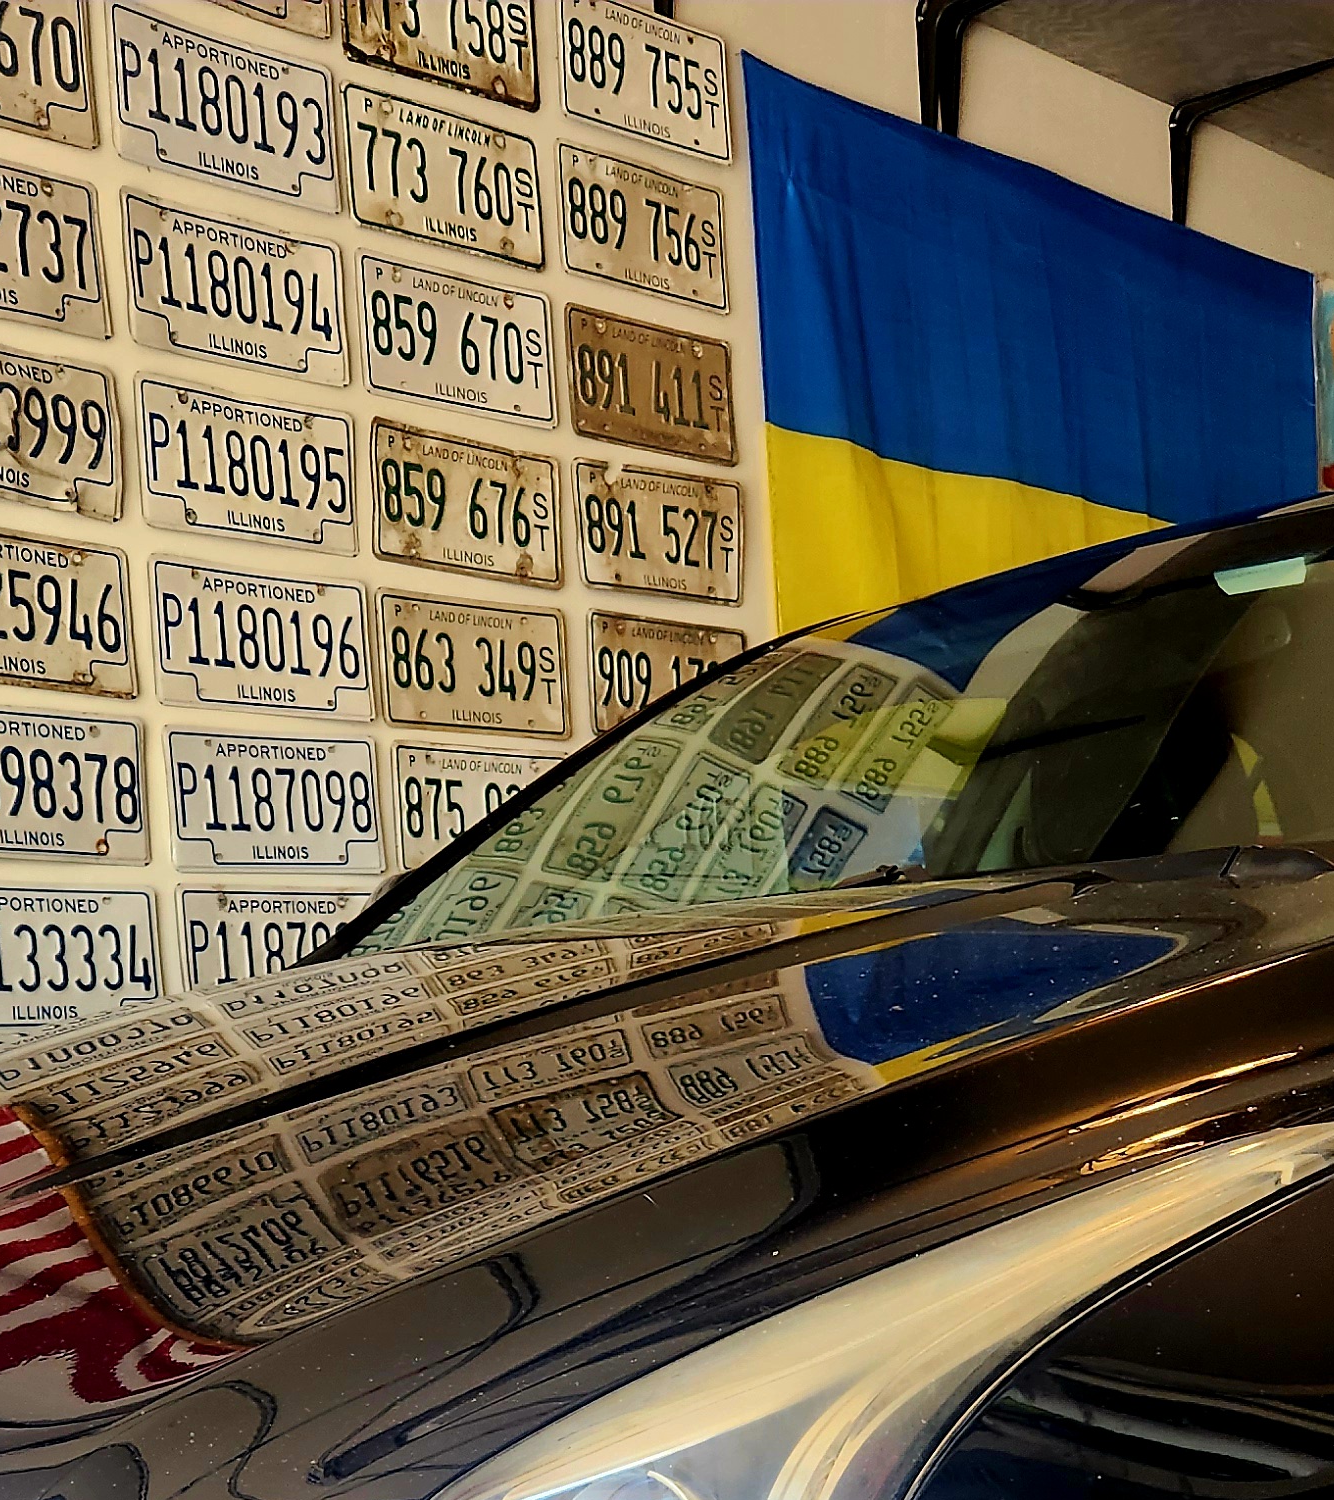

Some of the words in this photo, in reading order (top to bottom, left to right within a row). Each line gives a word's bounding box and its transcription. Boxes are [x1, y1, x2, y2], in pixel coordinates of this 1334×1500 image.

[605, 8, 629, 26] LAND
[631, 17, 643, 29] OF
[645, 25, 680, 44] LINCOLN
[162, 32, 279, 80] APPORTIONED
[418, 51, 470, 79] ILLINOIS
[568, 18, 625, 95] 889
[645, 44, 701, 120] 755
[120, 38, 326, 165] P1180193
[365, 98, 373, 112] P
[399, 109, 429, 128] LAND
[432, 118, 445, 133] OF
[448, 123, 491, 147] LINCOLN
[624, 114, 670, 138] ILLINOIS
[199, 151, 259, 180] ILLINOIS
[357, 121, 428, 203] 773
[449, 147, 514, 226] 760
[173, 219, 287, 258] APPORTIONED
[425, 216, 477, 242] ILLINOIS
[568, 177, 626, 250] 889
[645, 198, 700, 272] 756
[134, 228, 332, 341] P1180194
[413, 277, 440, 293] LAND
[442, 284, 455, 296] OF
[458, 287, 499, 307] LINCOLN
[625, 268, 670, 290] ILLINOIS
[209, 333, 267, 359] ILLINOIS
[371, 290, 437, 366] 859
[461, 312, 524, 384] 670
[435, 382, 488, 403] ILLINOIS
[577, 343, 635, 416] 891
[653, 360, 709, 430] 411
[191, 399, 302, 432] APPORTIONED
[149, 412, 346, 513] P1180195
[423, 444, 449, 460] LAND
[452, 451, 465, 463] OF
[467, 453, 509, 472] LINCOLN
[382, 458, 445, 531] 859
[469, 478, 531, 547] 676
[228, 510, 285, 532] ILLINOIS
[585, 494, 646, 560] 891
[663, 504, 717, 569] 527
[443, 548, 494, 567] ILLINOIS
[203, 577, 314, 603] APPORTIONED
[644, 575, 687, 590] ILLINOIS
[430, 610, 455, 623] LAND
[458, 613, 470, 625] OF
[473, 615, 512, 630] LINCOLN
[163, 593, 359, 679] P1180196
[392, 626, 456, 694] 863
[476, 637, 536, 701] 349
[238, 684, 296, 701] ILLINOIS
[598, 646, 651, 711] 909
[452, 709, 502, 724] ILLINOIS
[216, 743, 326, 761] APPORTIONED
[442, 759, 467, 771] LAND
[470, 761, 481, 771] OF
[484, 761, 522, 774] LINCOLN
[177, 762, 372, 833] P1187098
[405, 776, 465, 840] 875
[0, 829, 65, 846] ILLINOIS
[253, 846, 309, 860] ILLINOIS
[228, 900, 337, 914] APPORTIONED
[12, 1006, 78, 1021] ILLINOIS
